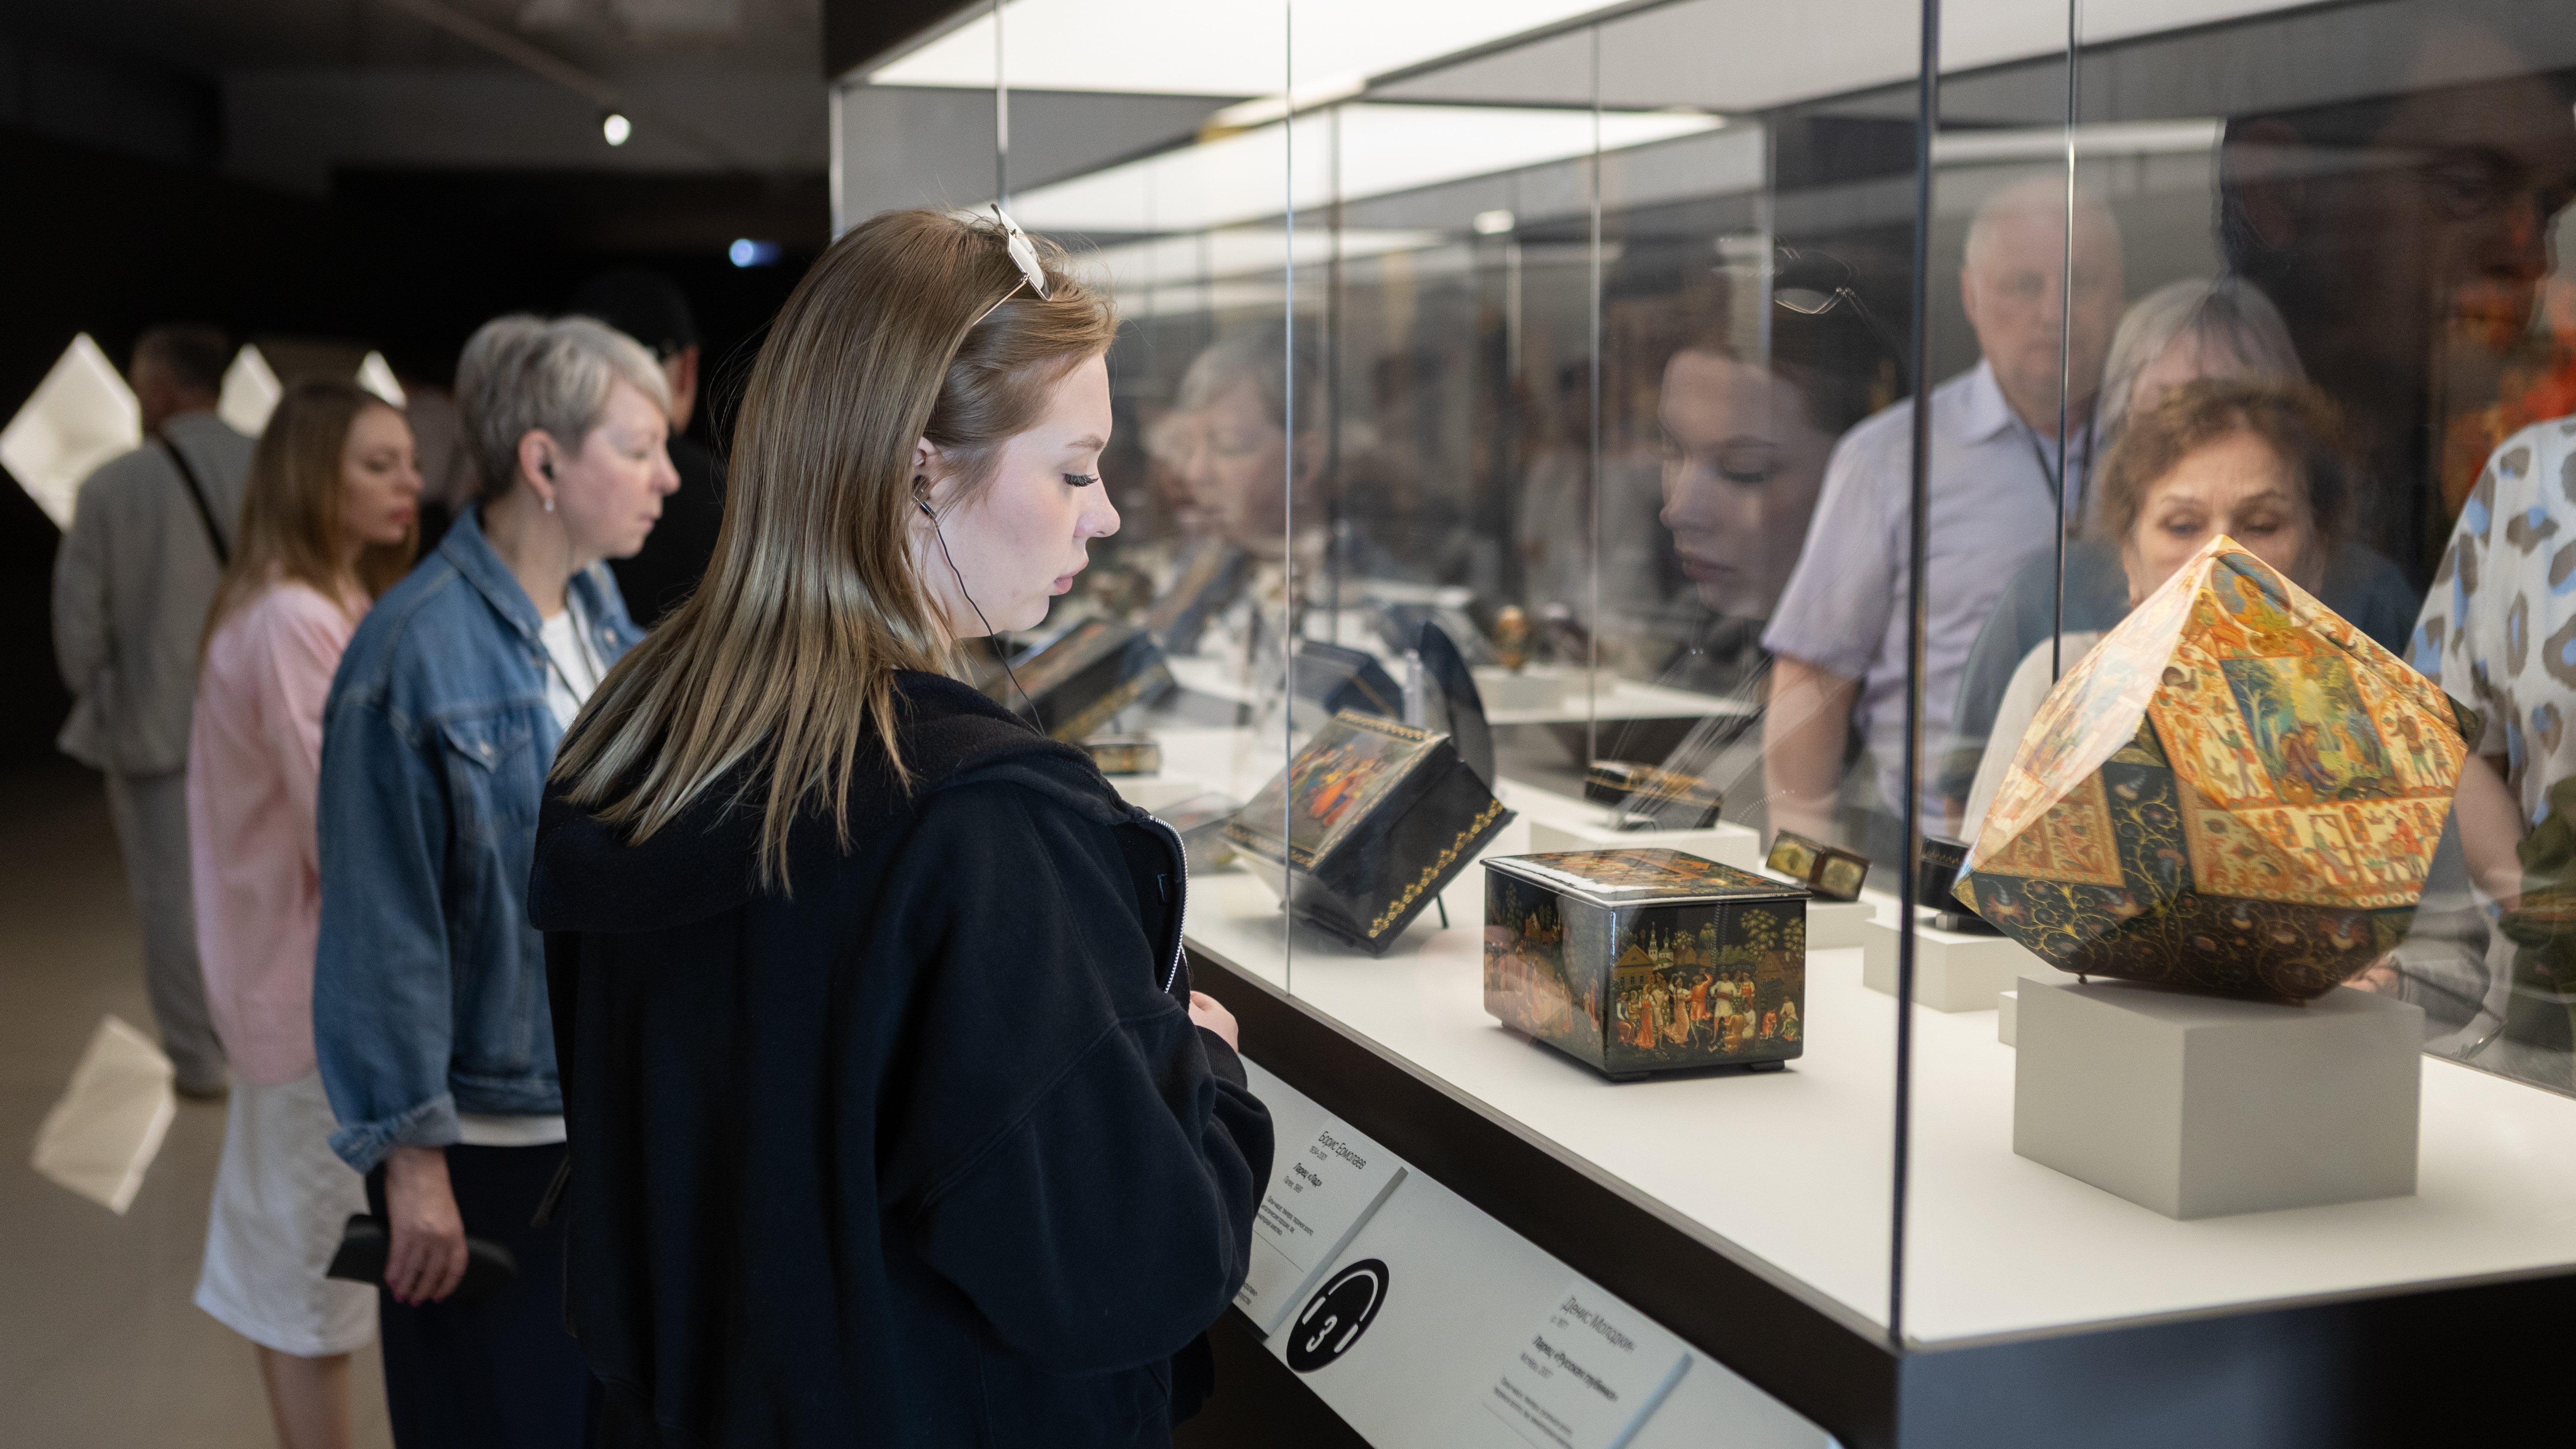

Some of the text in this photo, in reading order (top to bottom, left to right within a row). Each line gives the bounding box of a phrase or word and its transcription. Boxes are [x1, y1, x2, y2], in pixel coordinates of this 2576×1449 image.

[1318, 1131, 1366, 1170] Борис Ермолаев
[1293, 1163, 1309, 1180] Ларец
[1306, 1315, 1338, 1352] 3
[1561, 1295, 1636, 1353] Денис Молодкин
[1532, 1335, 1555, 1359] Ларец
